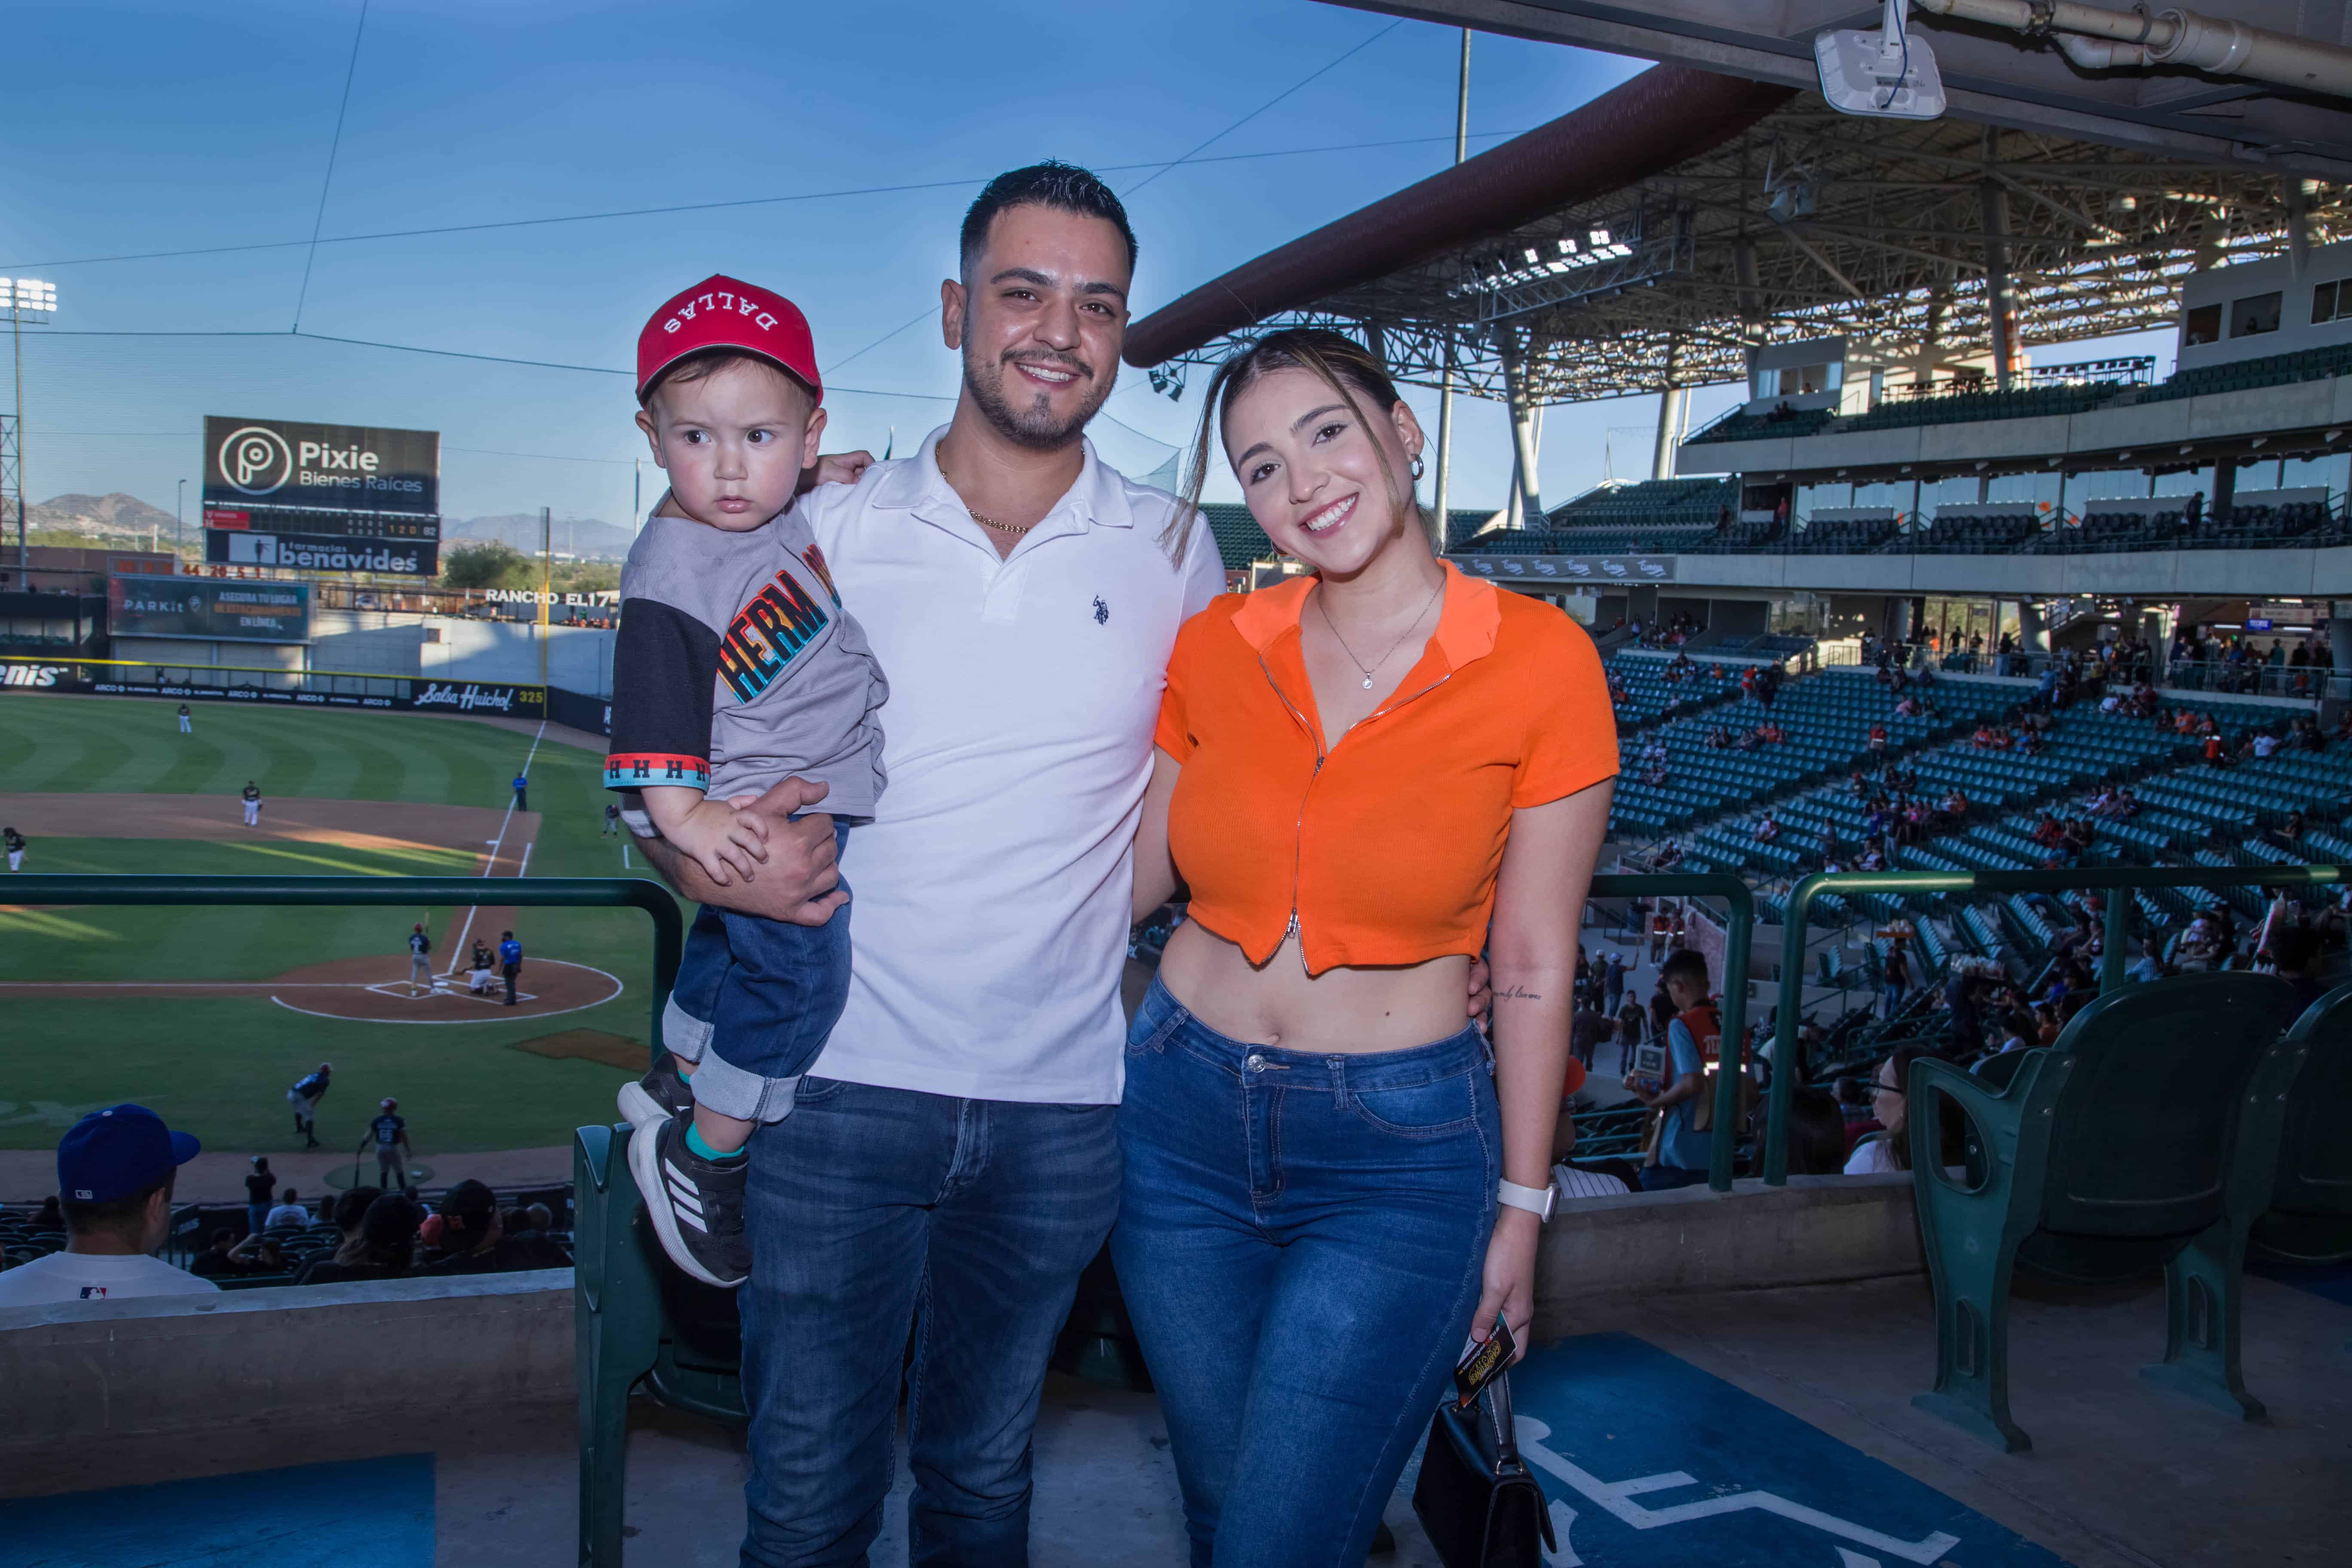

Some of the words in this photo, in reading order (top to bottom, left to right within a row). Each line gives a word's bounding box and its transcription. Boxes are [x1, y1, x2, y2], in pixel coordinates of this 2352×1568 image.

[664, 290, 778, 334] DALLAS
[299, 441, 379, 471] Pixie
[300, 471, 361, 489] Bienes
[366, 475, 423, 493] Raíces
[279, 542, 417, 572] benavides
[289, 542, 347, 553] farmacias
[124, 599, 184, 613] PARKit
[486, 589, 559, 605] RANCHO
[414, 683, 459, 705] Salsa
[459, 684, 513, 711] Huichol
[520, 691, 543, 703] 325
[610, 760, 620, 778] H
[633, 760, 650, 778] H
[666, 760, 683, 779] H
[696, 763, 706, 781] H
